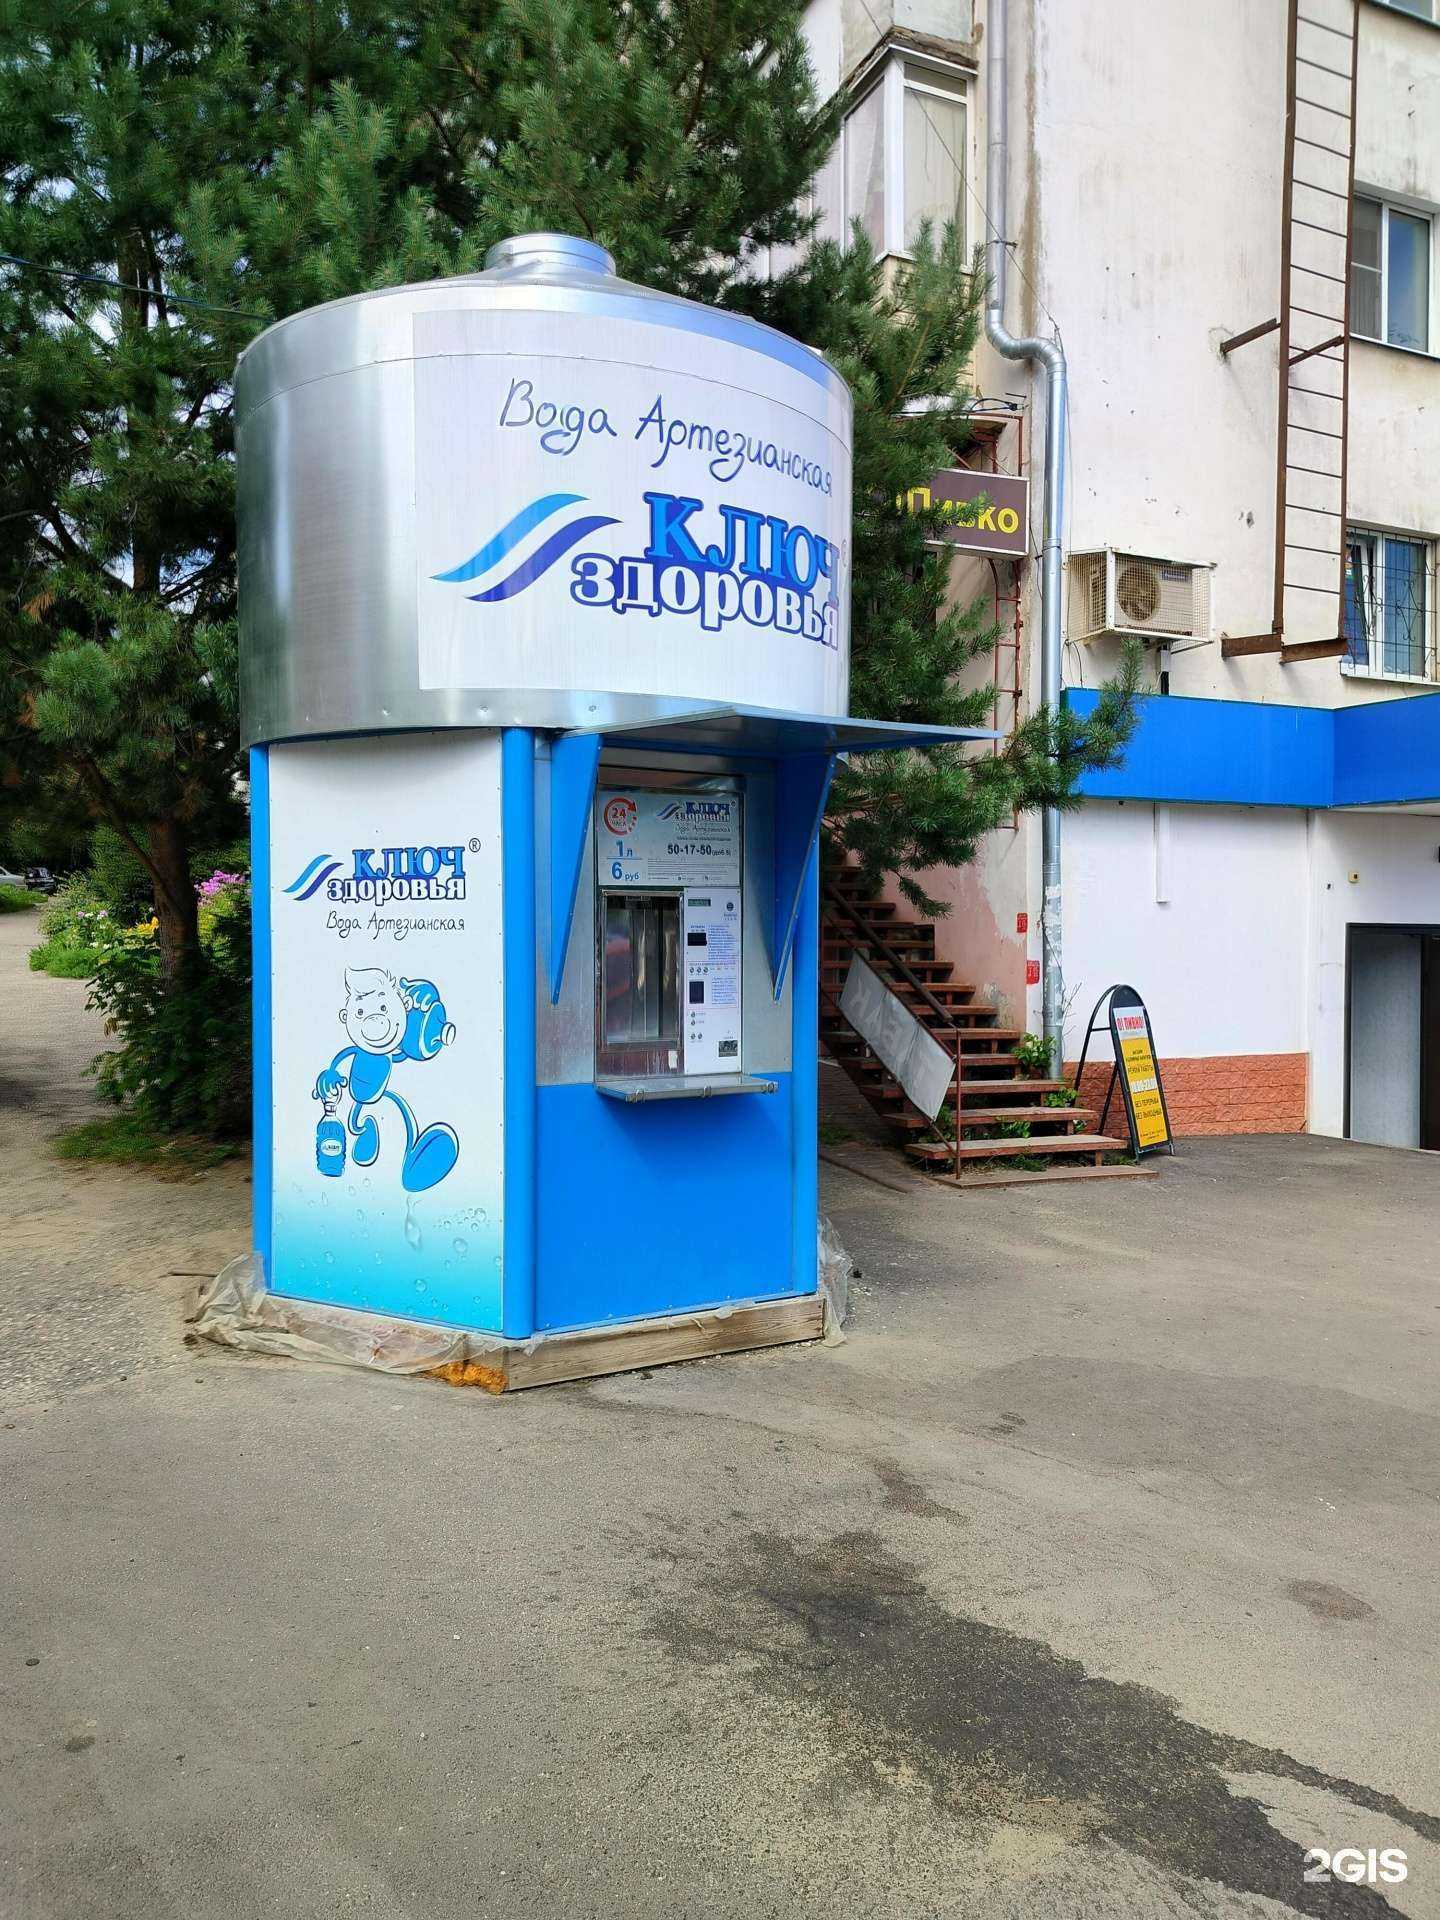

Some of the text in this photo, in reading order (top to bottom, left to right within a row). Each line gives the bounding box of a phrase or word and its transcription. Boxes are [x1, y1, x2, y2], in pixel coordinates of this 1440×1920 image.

[499, 378, 833, 497] Вода Артезианская
[615, 840, 624, 857] 1
[667, 844, 712, 856] 50-17-50
[611, 862, 623, 880] 6
[327, 877, 466, 906] здоровья
[326, 910, 465, 941] Вода Артезианская
